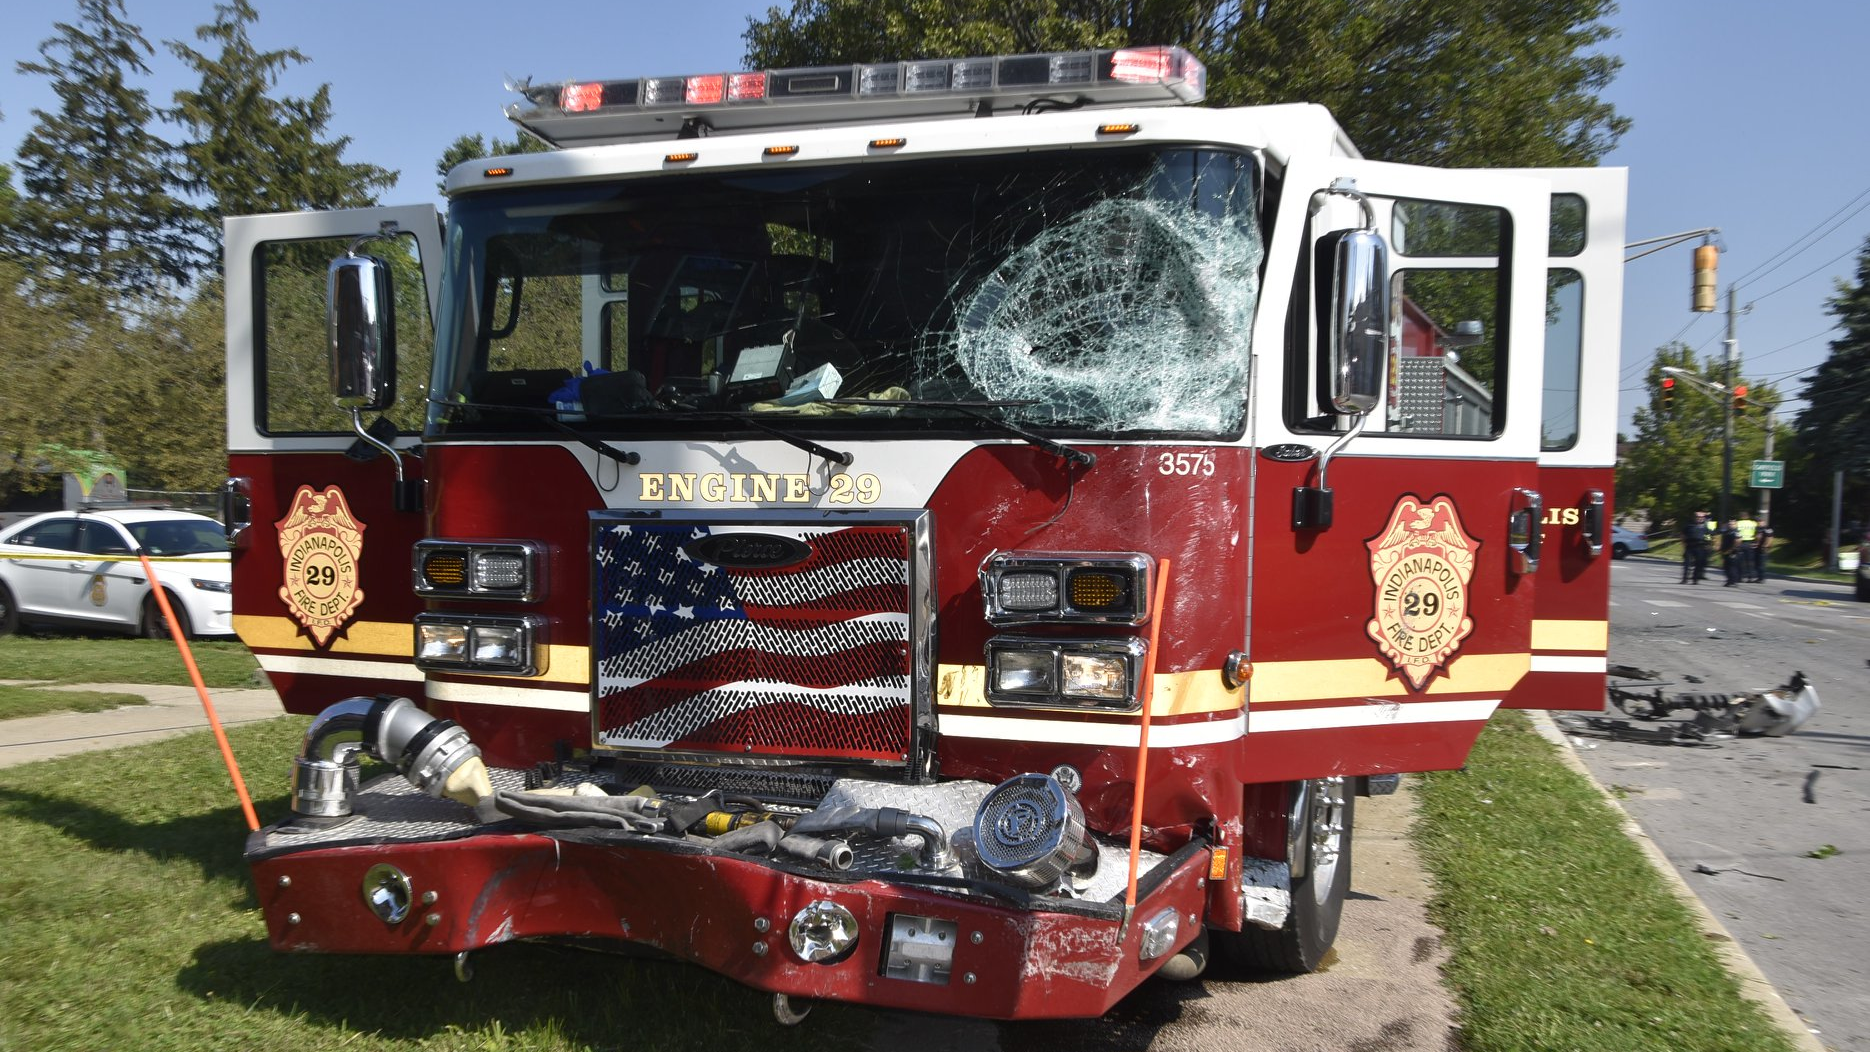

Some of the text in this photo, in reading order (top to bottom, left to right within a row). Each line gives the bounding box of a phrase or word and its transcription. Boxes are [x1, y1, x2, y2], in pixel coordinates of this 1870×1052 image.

[1158, 452, 1215, 476] 3575
[639, 473, 882, 504] ENGINE 29
[290, 536, 352, 573] INDIANAPOLIS
[306, 565, 335, 586] 29
[1384, 558, 1460, 602] INDIANAPOLIS
[294, 589, 349, 616] FIRE DEPT.
[1404, 592, 1440, 617] 29
[1387, 622, 1455, 653] FIRE DEPT.
